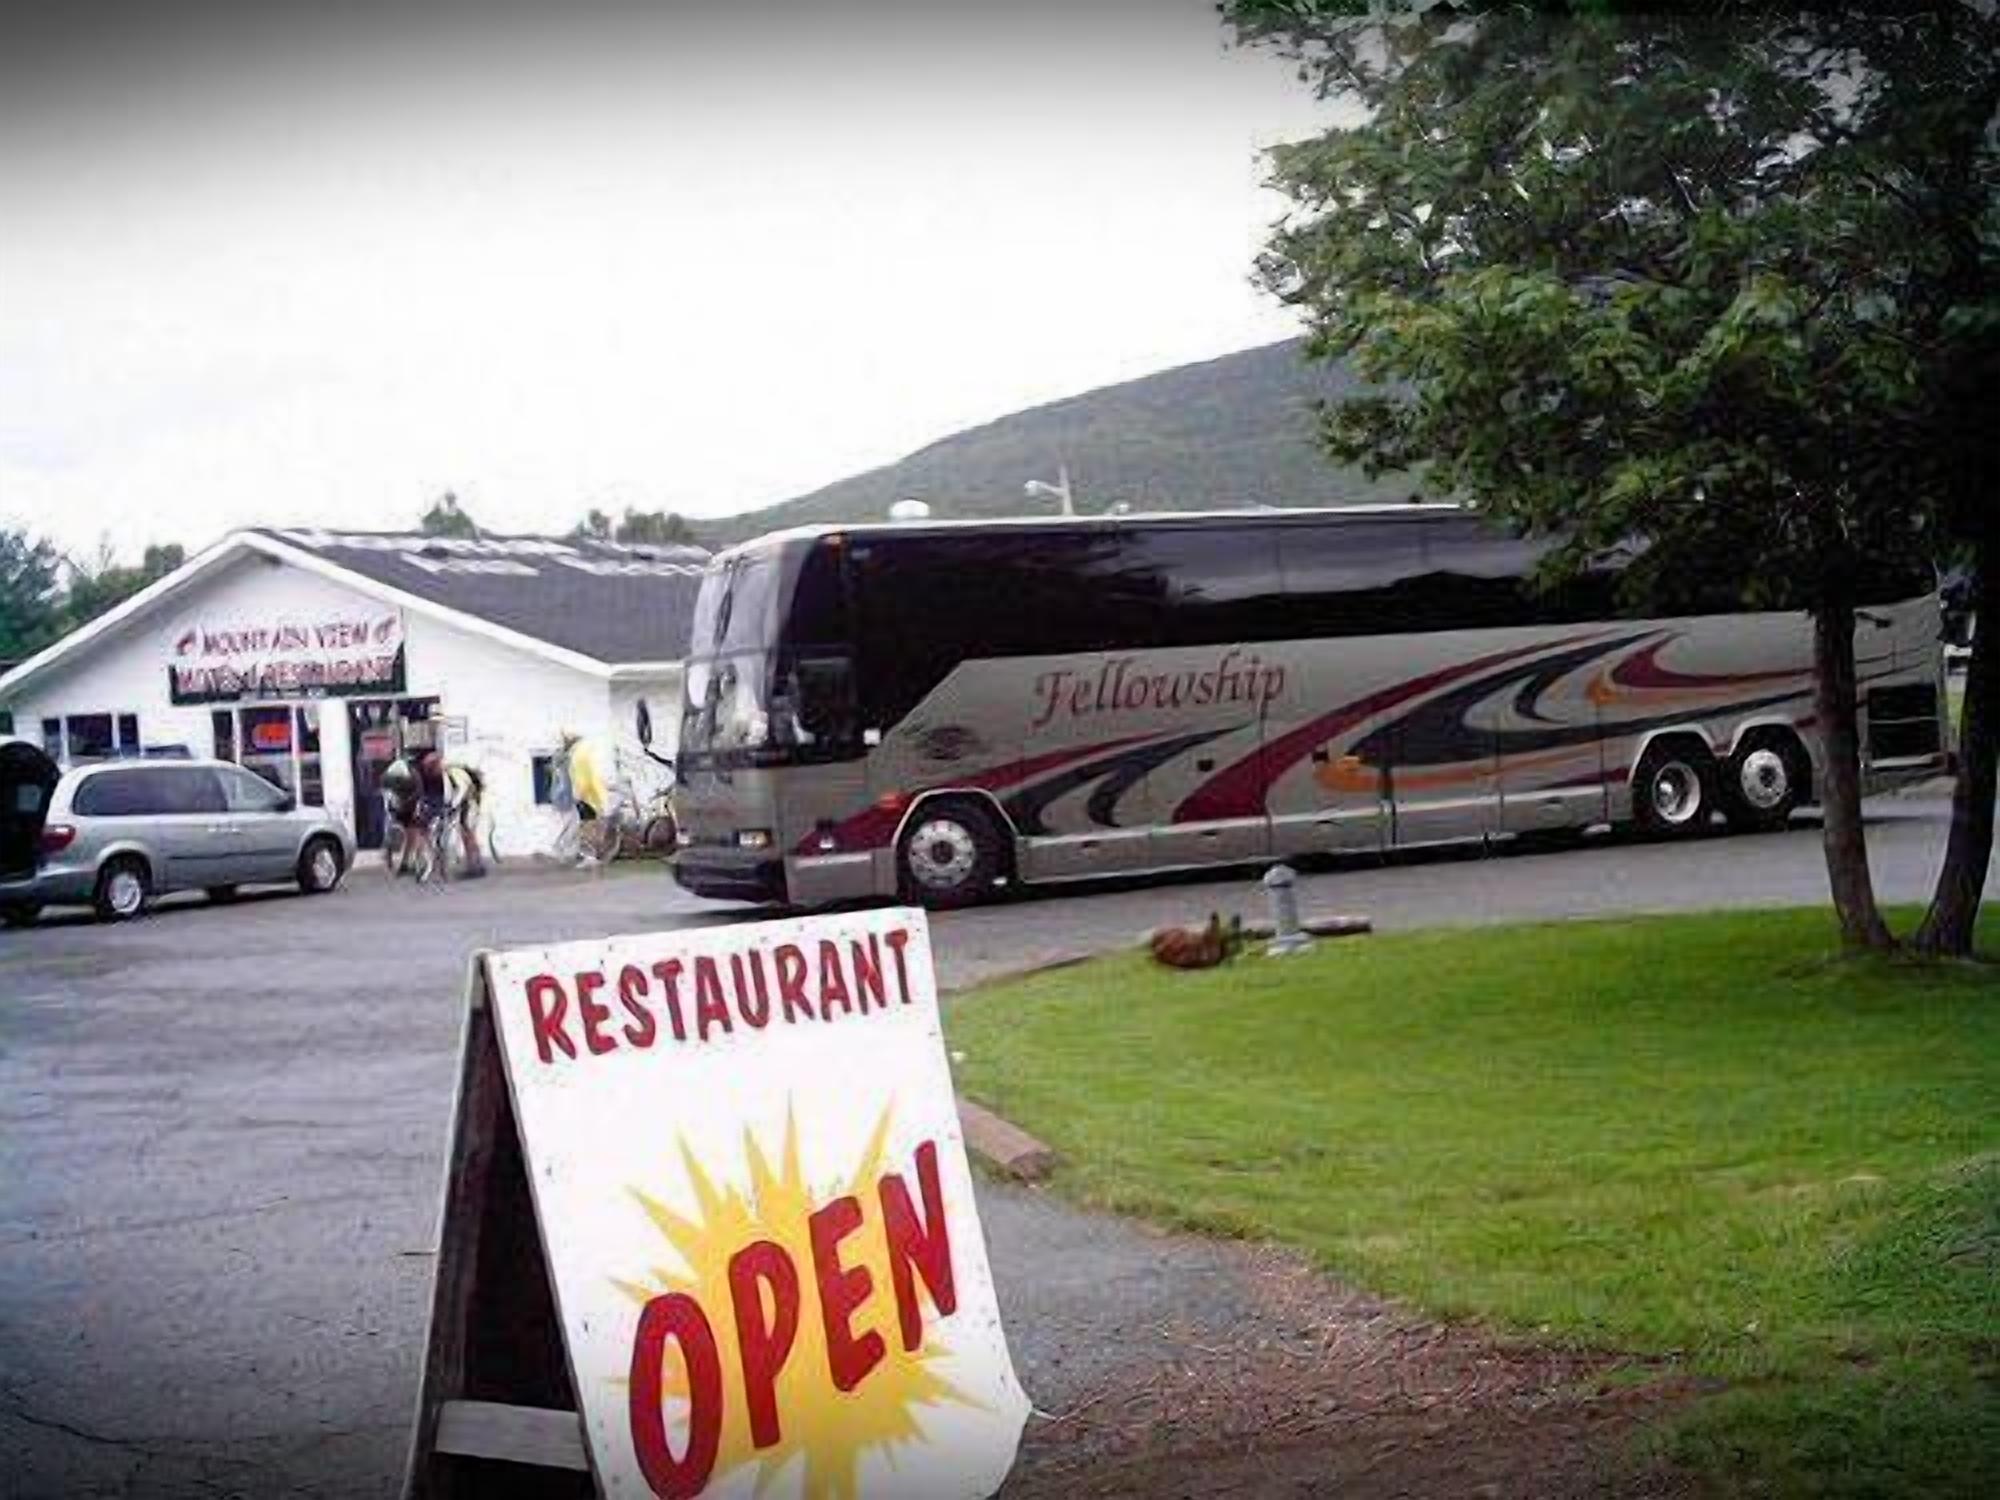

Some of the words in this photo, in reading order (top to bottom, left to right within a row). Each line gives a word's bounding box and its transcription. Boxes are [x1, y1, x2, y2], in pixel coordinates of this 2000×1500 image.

[1032, 650, 1284, 734] Fellowship
[525, 929, 912, 1064] RESTAURANT
[629, 1140, 957, 1500] OPEN
